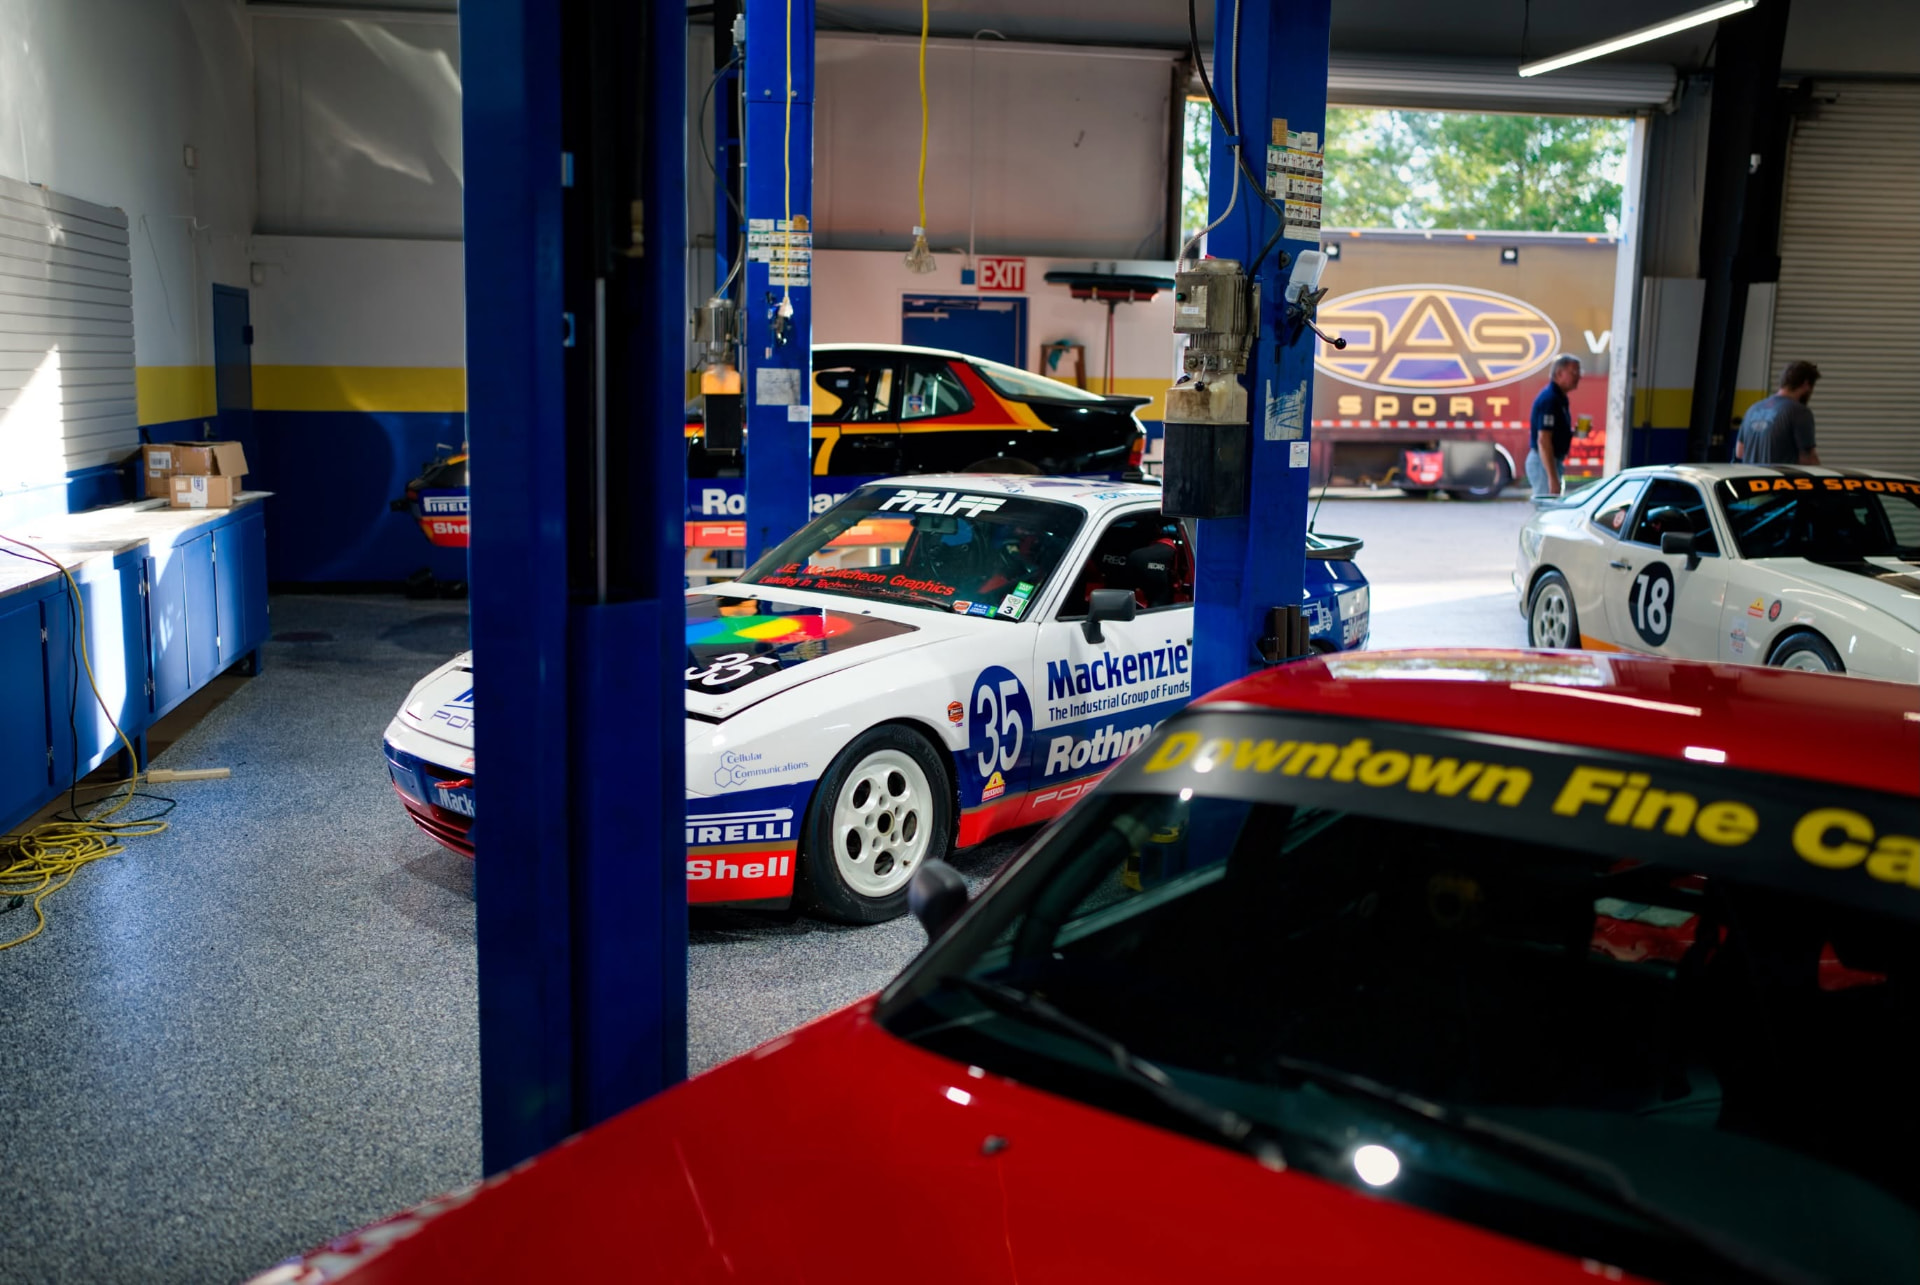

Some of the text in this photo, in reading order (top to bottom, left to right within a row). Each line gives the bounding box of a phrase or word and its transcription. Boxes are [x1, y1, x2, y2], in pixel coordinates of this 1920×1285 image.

[980, 261, 1025, 288] EXIT
[1338, 395, 1510, 420] SPORT
[1748, 478, 1920, 495] DAS SPORT
[878, 489, 1007, 518] PFAFF
[889, 574, 956, 596] Graphics
[1003, 606, 1014, 615] 3
[1635, 574, 1671, 635] 18
[685, 652, 779, 686] 35
[1047, 639, 1189, 701] Mackenzie
[1049, 680, 1190, 722] The Industrial Group of Funds
[976, 678, 1024, 778] 35
[727, 752, 762, 764] Cellular
[1044, 718, 1167, 777] Rothm
[735, 761, 809, 779] Communications
[1143, 730, 1533, 807] Downtown
[1552, 765, 1760, 846] Fine
[686, 856, 789, 881] Shell
